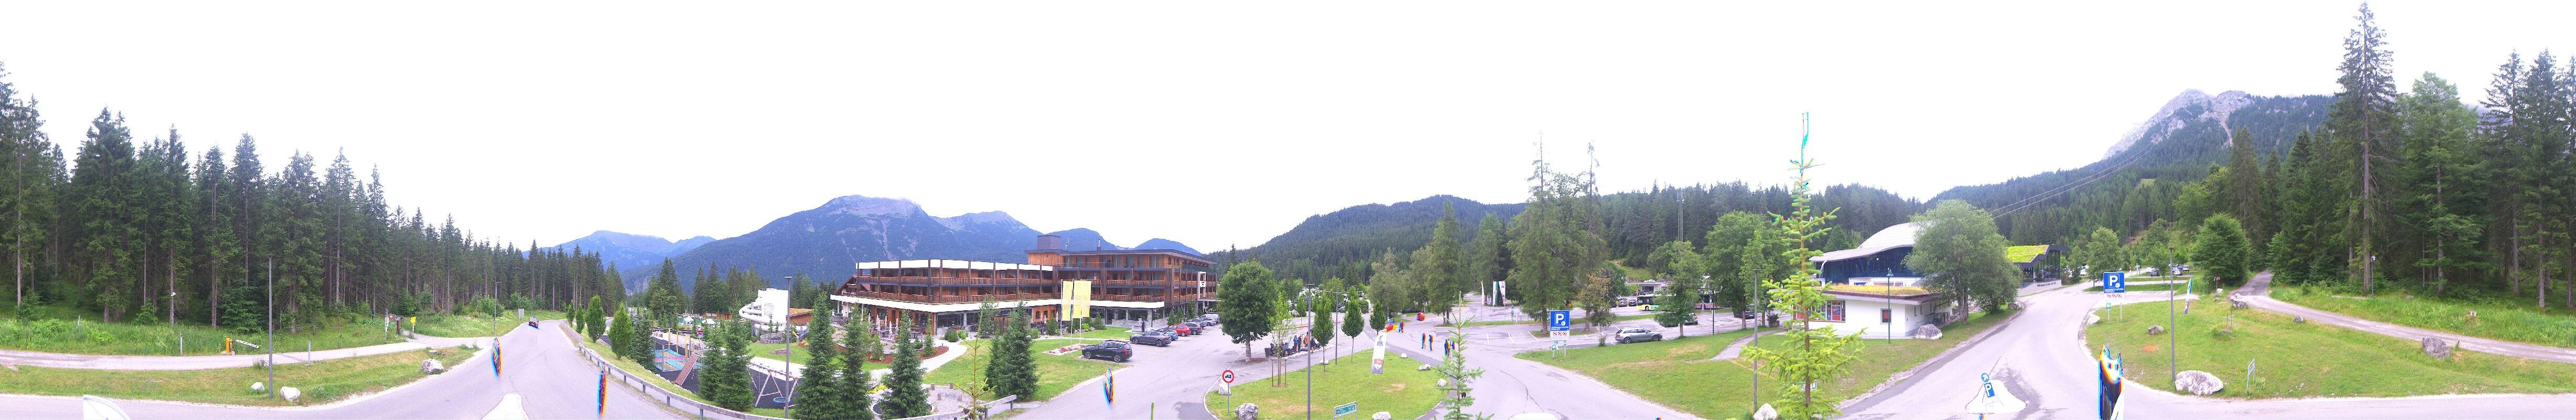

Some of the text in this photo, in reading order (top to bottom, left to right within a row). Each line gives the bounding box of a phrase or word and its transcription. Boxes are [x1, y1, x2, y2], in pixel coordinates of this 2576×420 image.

[2109, 275, 2118, 287] P
[1556, 313, 1564, 324] P
[1985, 384, 1992, 397] P
